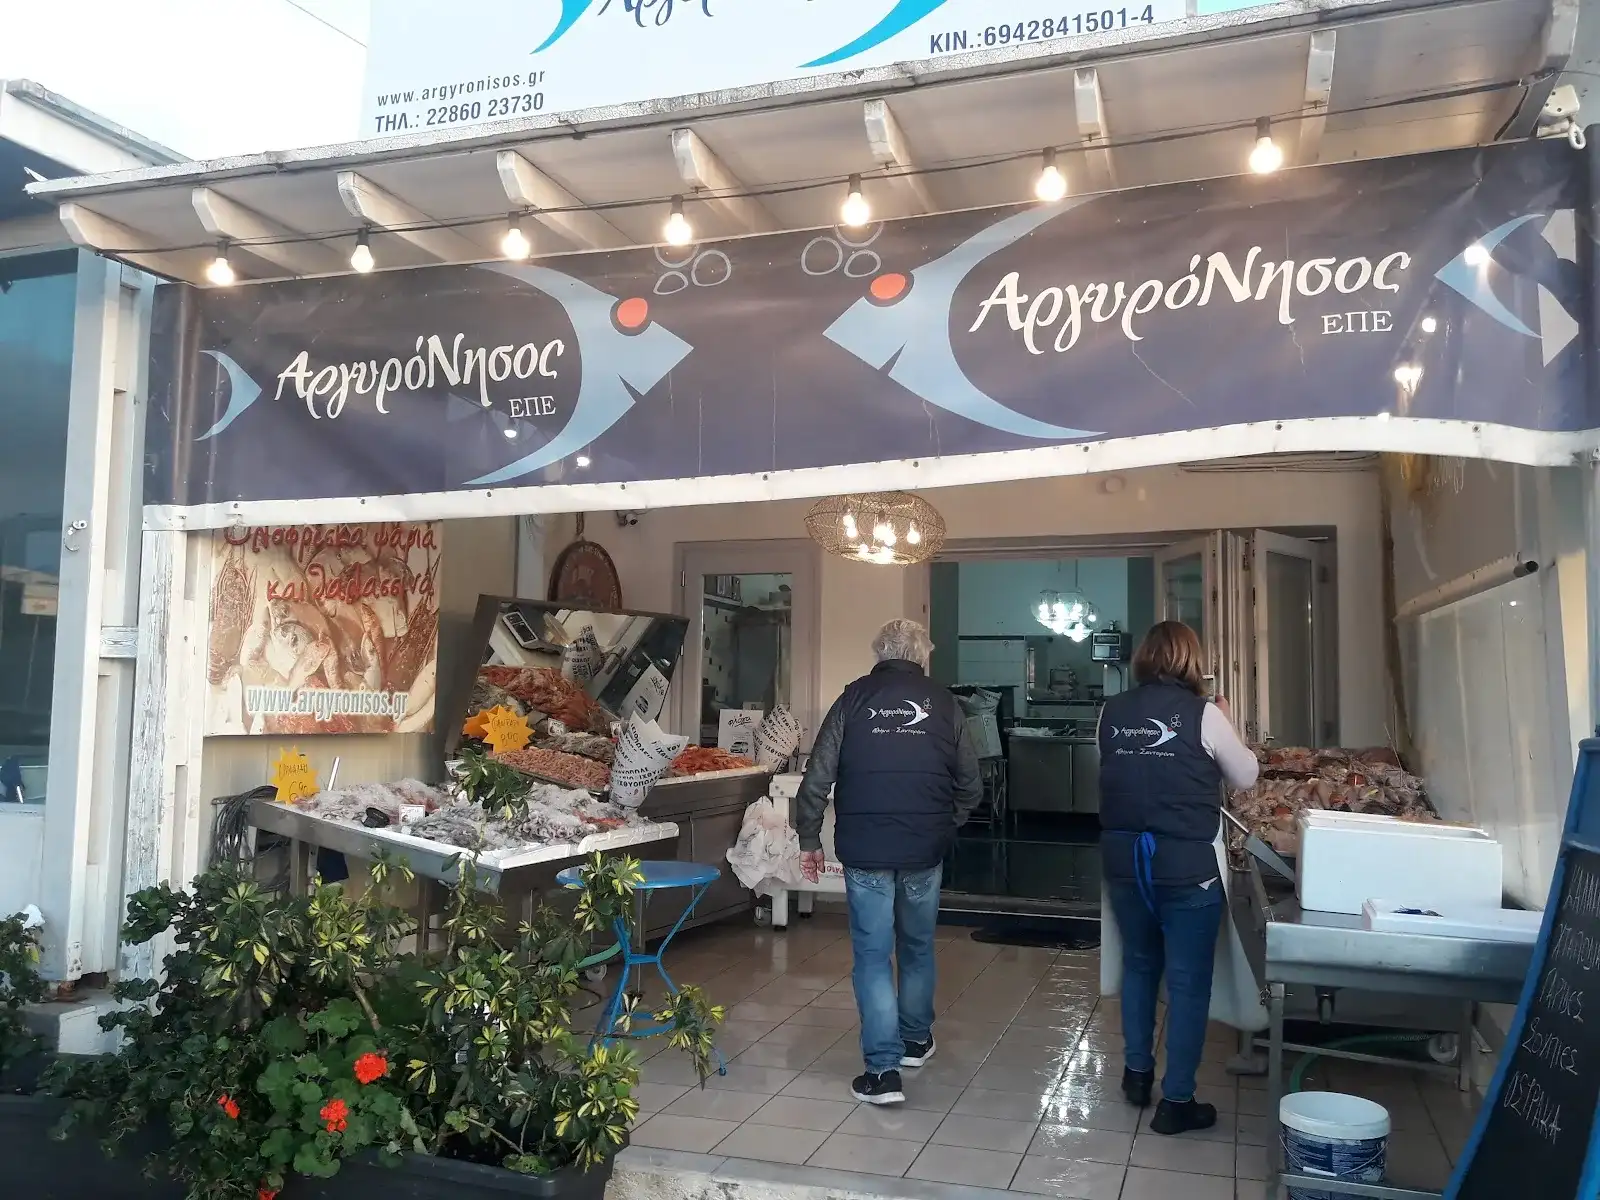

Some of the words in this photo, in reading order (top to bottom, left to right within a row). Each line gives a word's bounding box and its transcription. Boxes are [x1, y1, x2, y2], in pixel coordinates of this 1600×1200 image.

[377, 70, 545, 107] www.argyronisos.gr
[375, 112, 420, 133] ΤΗΛ.:
[426, 101, 481, 126] 22860
[488, 92, 544, 117] 23730
[968, 245, 1412, 355] ΑργυρόΝησος
[1321, 310, 1394, 336] ΕΠΕ
[273, 332, 565, 420] ΑργυρόΝησος
[508, 395, 557, 418] ΕΠΕ
[266, 579, 304, 601] και
[247, 687, 409, 721] www.argyronisos.gr
